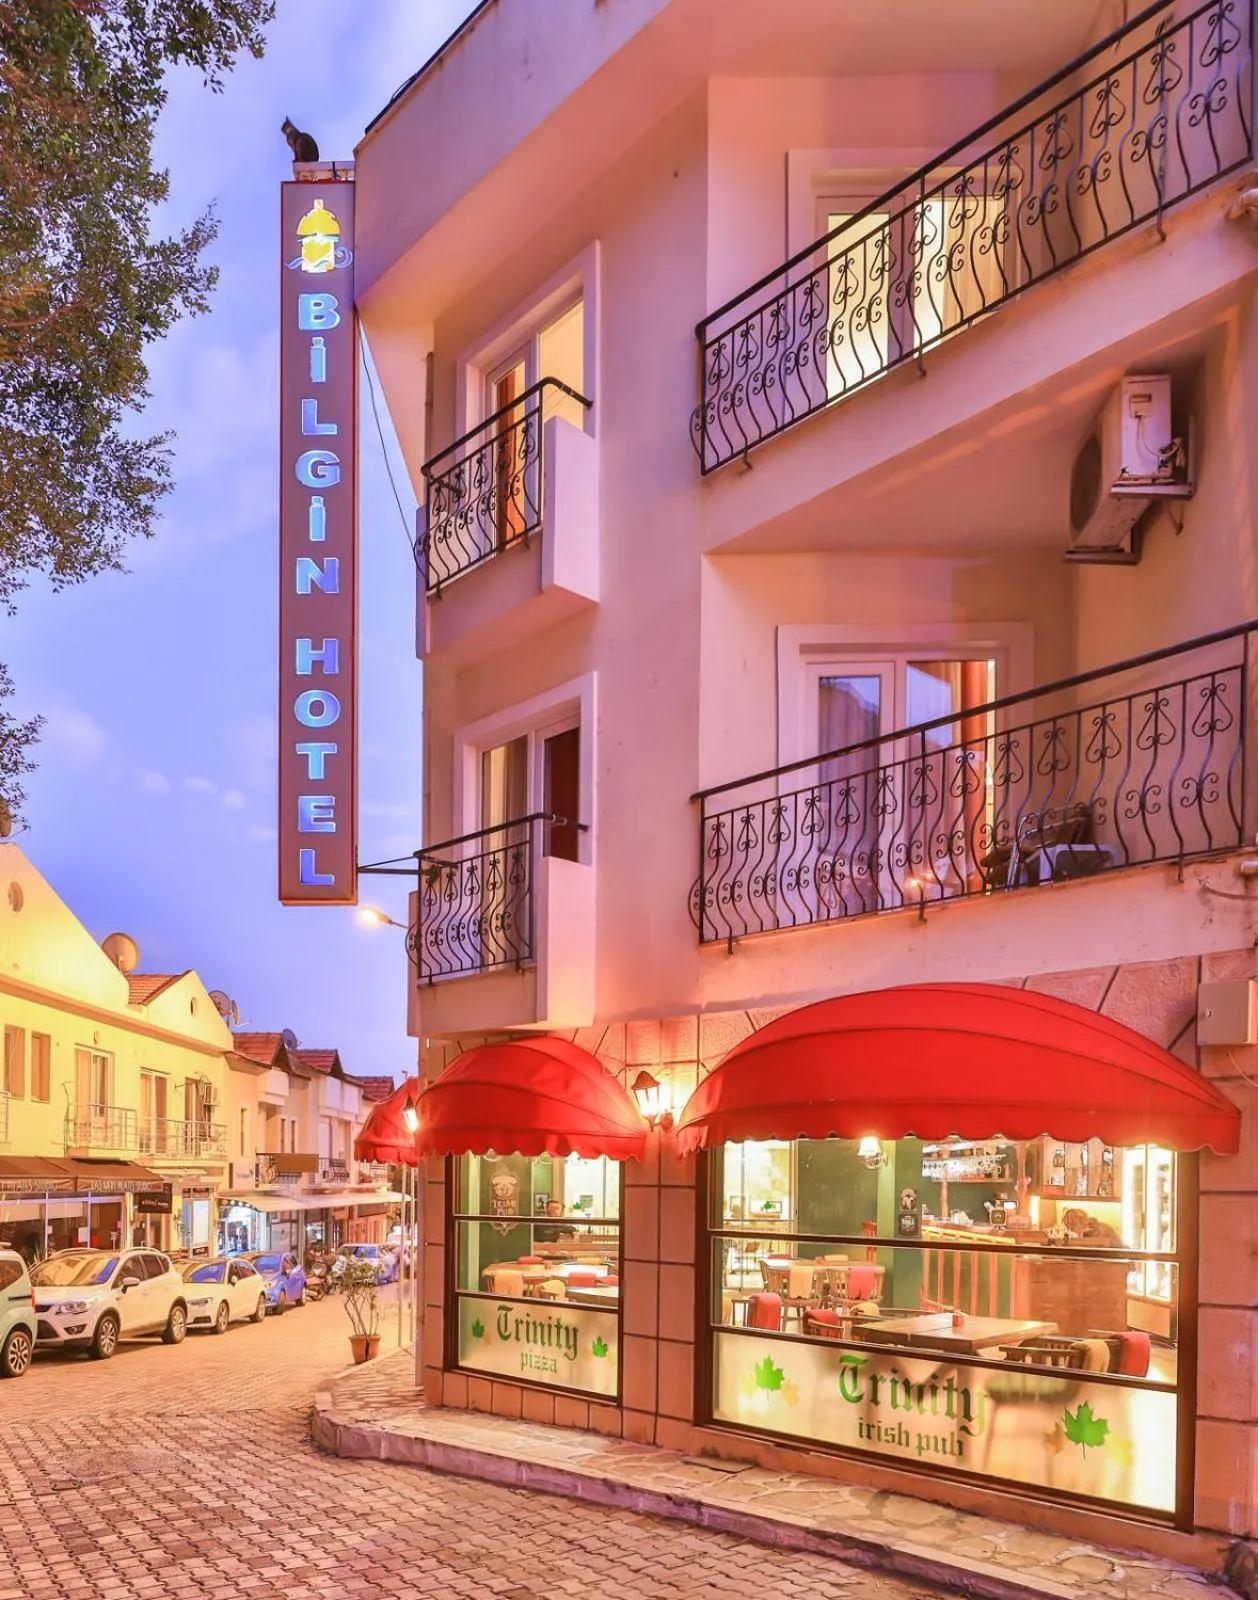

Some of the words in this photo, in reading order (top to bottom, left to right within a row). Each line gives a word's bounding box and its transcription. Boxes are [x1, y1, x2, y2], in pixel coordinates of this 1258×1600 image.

[294, 638, 341, 885] HOTEL
[497, 1304, 578, 1361] Trinity
[520, 1349, 557, 1373] pizza
[838, 1354, 987, 1437] Trinity
[857, 1417, 910, 1448] irish
[915, 1431, 964, 1457] pub
